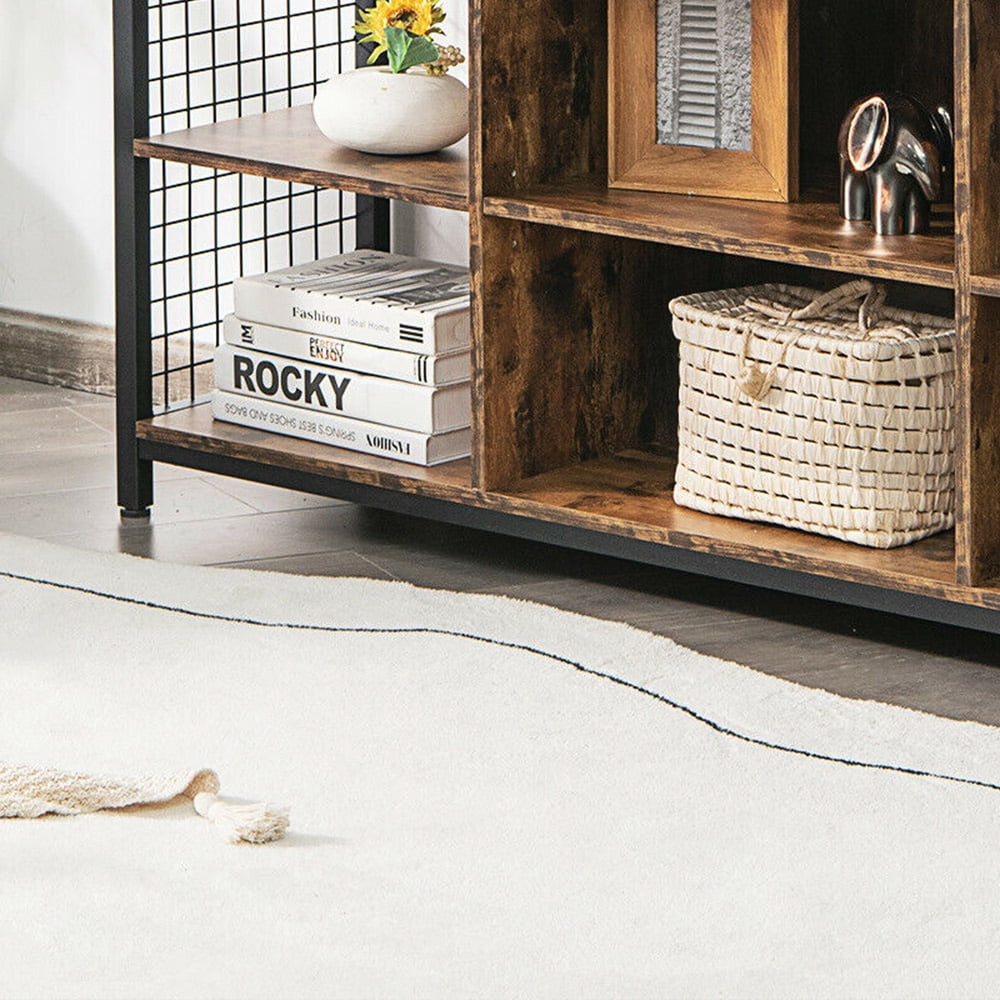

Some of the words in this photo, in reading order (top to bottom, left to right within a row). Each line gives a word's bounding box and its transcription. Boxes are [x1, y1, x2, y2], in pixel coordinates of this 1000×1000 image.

[292, 307, 341, 325] Fashion
[309, 337, 345, 349] PERFECT
[309, 345, 344, 363] ENJOY
[234, 354, 351, 411] ROCKY
[225, 402, 247, 417] BAGS
[249, 408, 267, 422] AND
[269, 411, 297, 429] SHOES
[299, 420, 316, 433] BEST
[366, 433, 410, 455] FASHION
